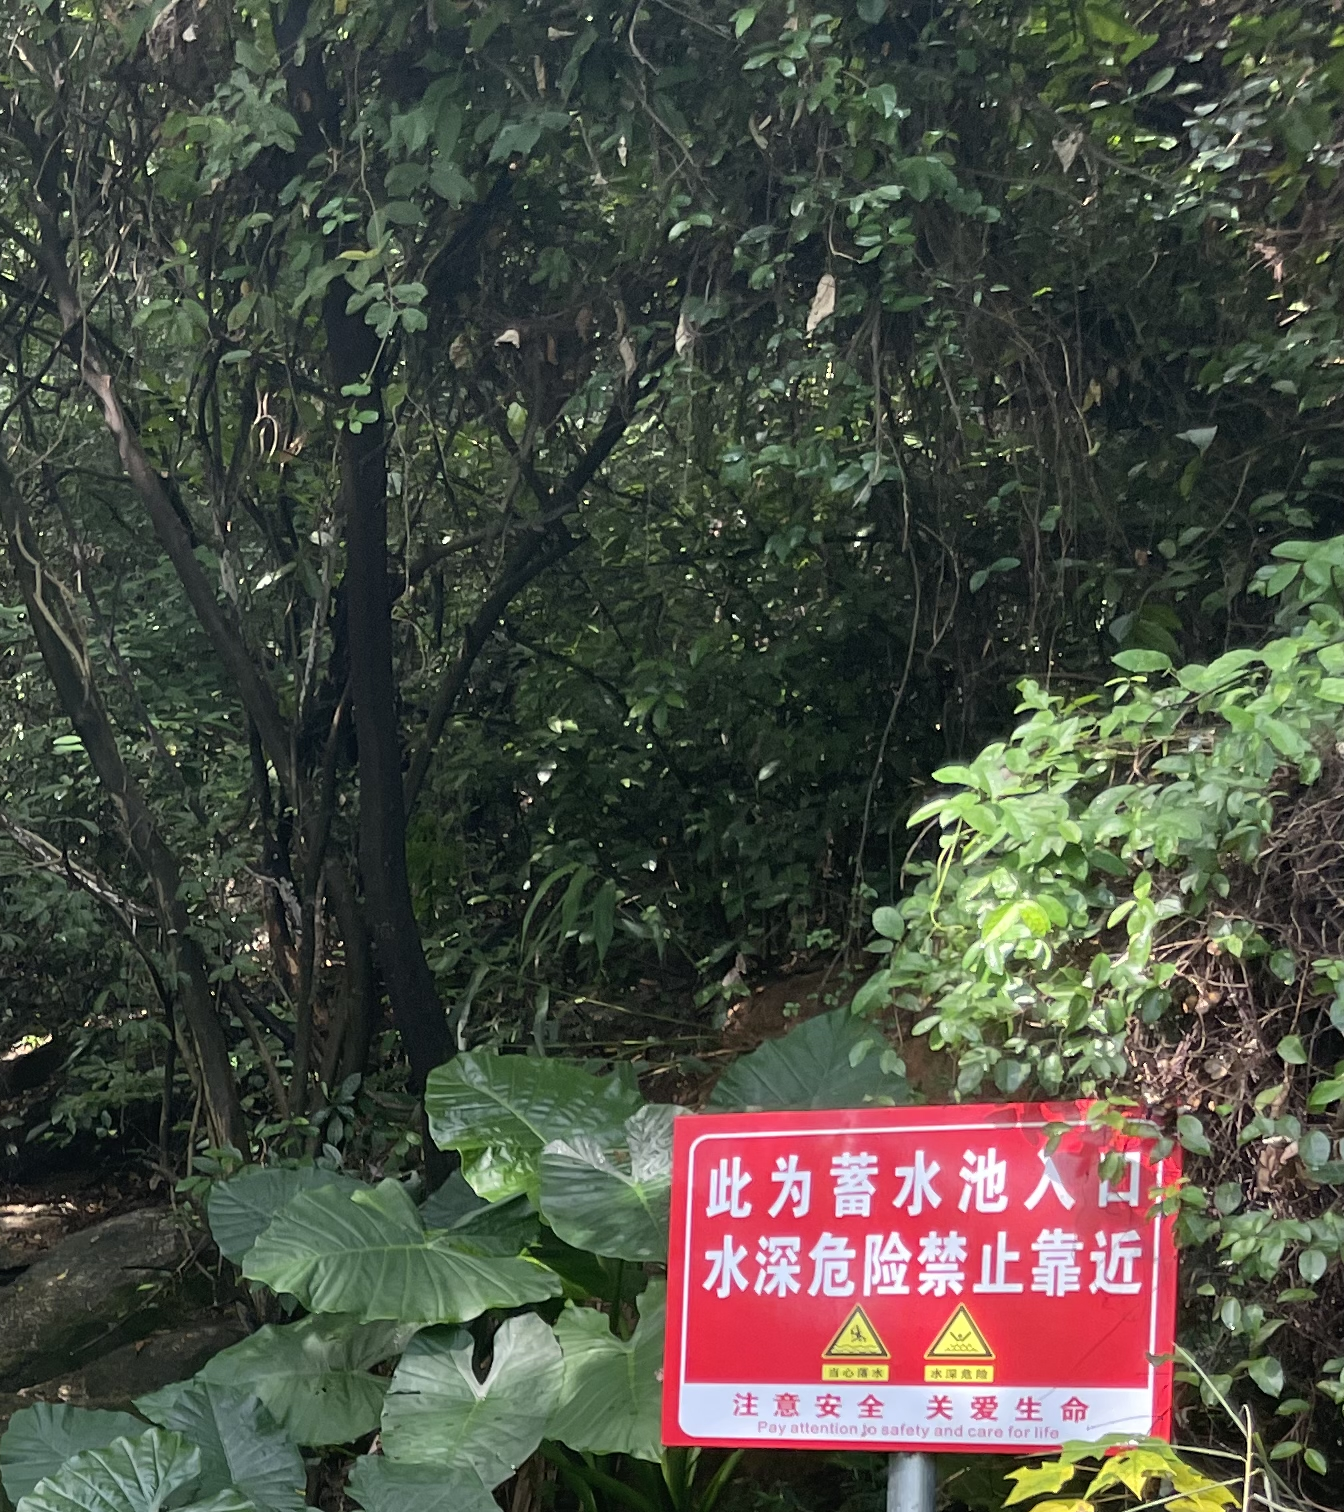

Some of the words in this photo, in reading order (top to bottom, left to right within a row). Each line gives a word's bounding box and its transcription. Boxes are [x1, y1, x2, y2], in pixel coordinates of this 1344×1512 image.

[705, 1147, 1141, 1219] 此为蓄水池入口
[702, 1228, 1143, 1299] 水深危险禁止靠近
[930, 1368, 988, 1380] 水深危险
[733, 1392, 884, 1419] 注意安全
[926, 1395, 1089, 1423] 关爱生命
[757, 1421, 787, 1437] Pay
[790, 1422, 858, 1436] attention
[862, 1423, 878, 1436] to
[881, 1423, 930, 1439] safety
[934, 1424, 963, 1438] and
[967, 1427, 1003, 1439] care
[1008, 1425, 1031, 1439] for
[1034, 1426, 1059, 1440] life
